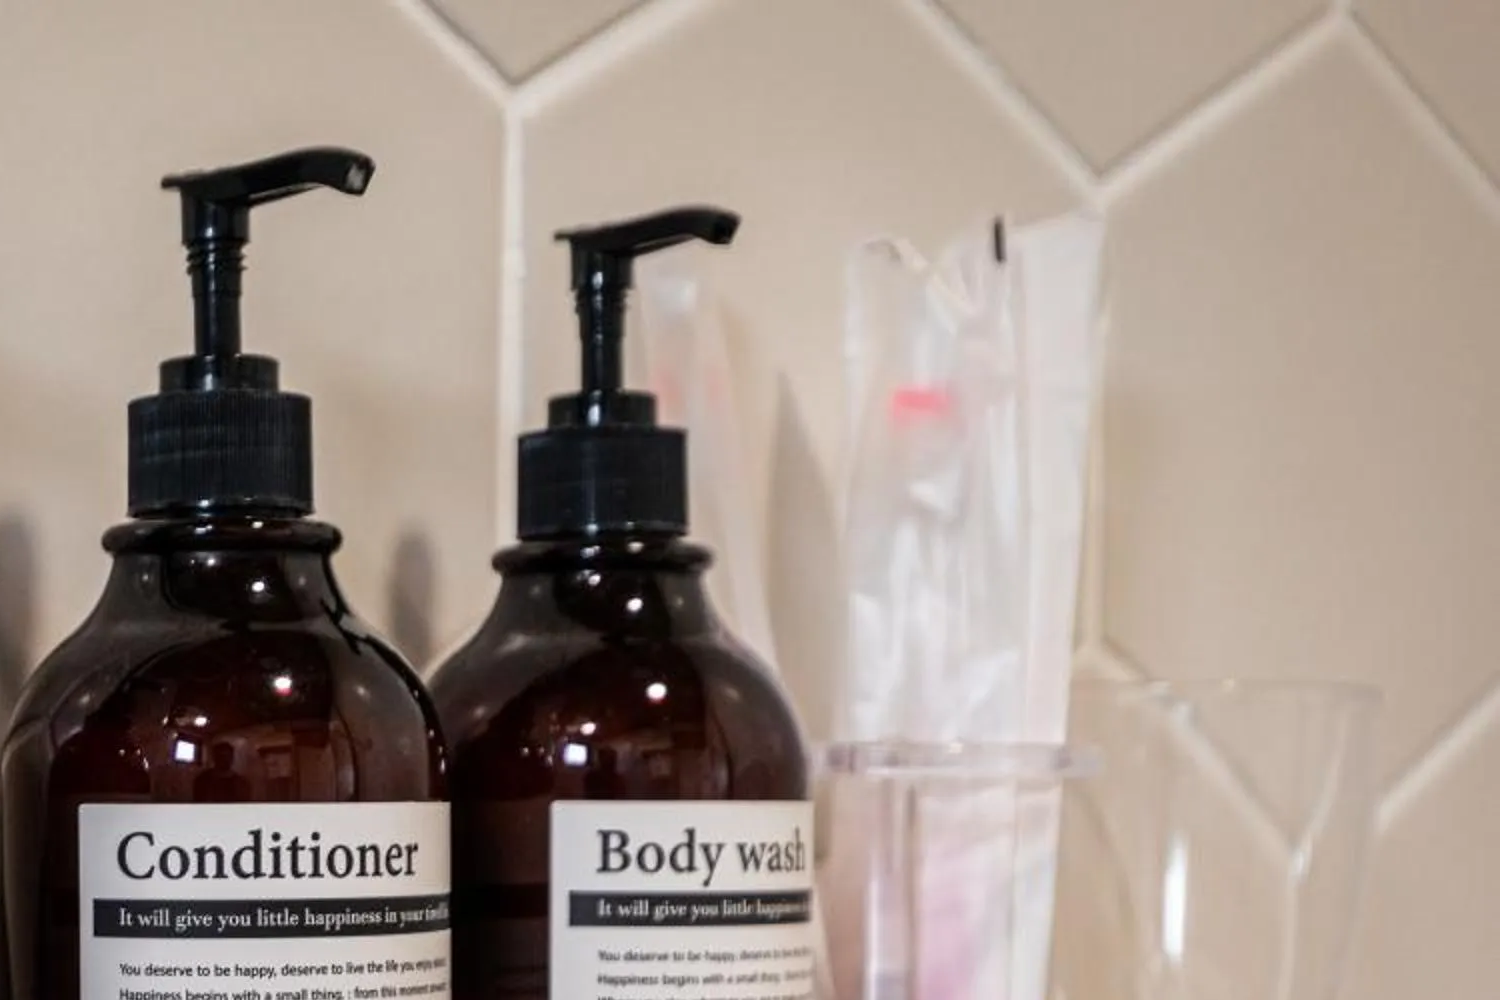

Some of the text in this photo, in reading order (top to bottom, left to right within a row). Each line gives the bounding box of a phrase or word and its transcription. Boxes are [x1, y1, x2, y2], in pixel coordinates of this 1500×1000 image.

[116, 828, 419, 880] Conditioner
[596, 827, 806, 887] Body wash
[119, 907, 133, 926] It
[137, 908, 170, 927] will
[175, 909, 213, 932] give
[217, 914, 252, 931] you
[256, 907, 299, 926] little
[304, 907, 383, 931] happiness
[384, 906, 398, 922] in
[399, 909, 425, 925] your
[597, 898, 751, 921] It will give you little
[597, 950, 621, 962] You
[119, 959, 398, 980] You deserve to be happy, deserve to live the life
[596, 974, 659, 988] Happiness
[353, 986, 379, 999] from
[380, 986, 397, 999] this
